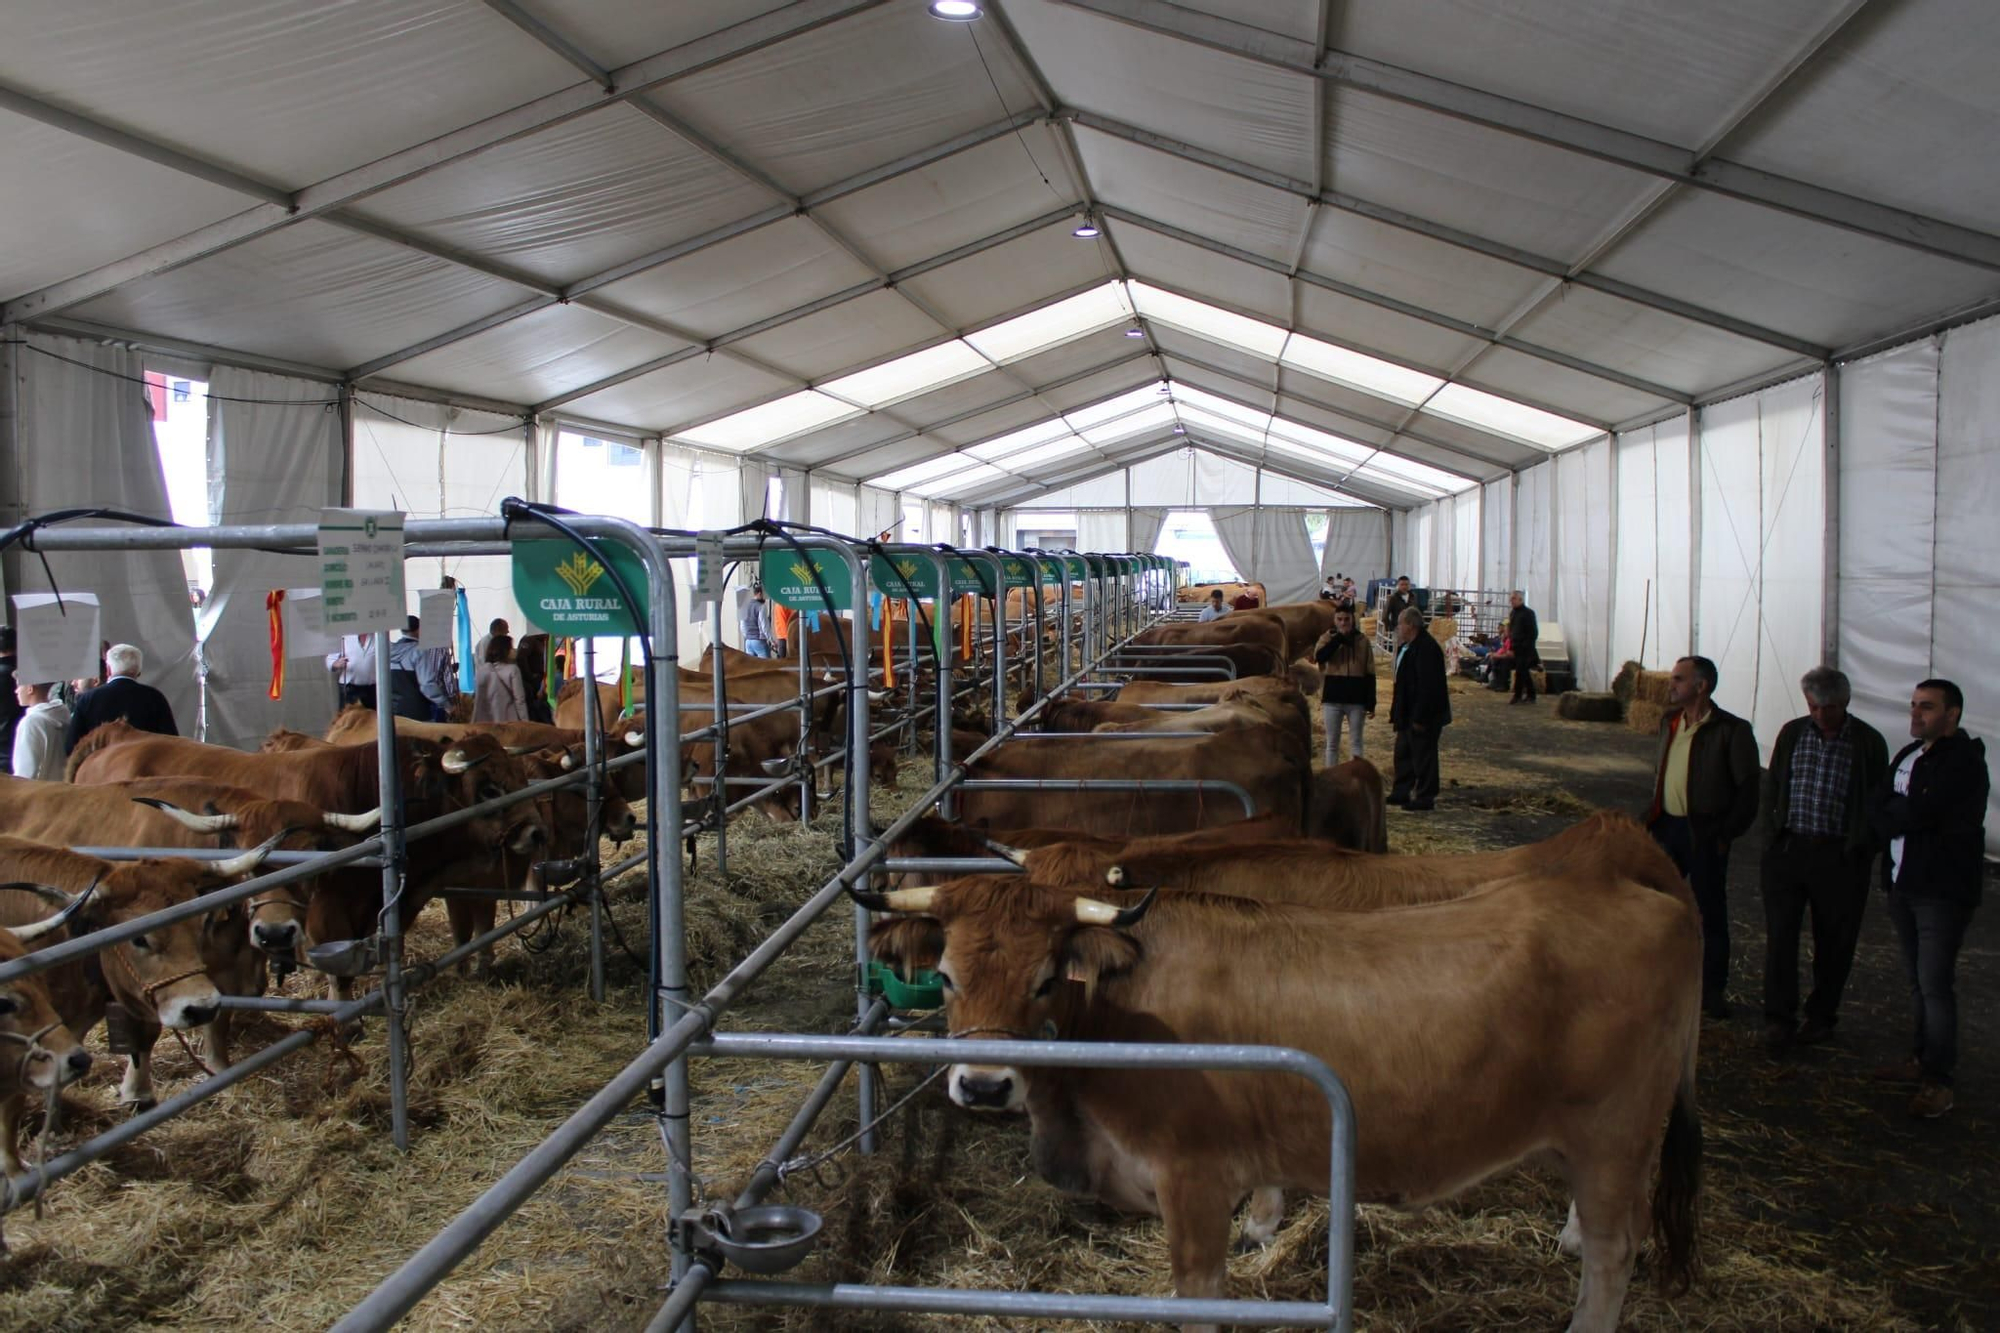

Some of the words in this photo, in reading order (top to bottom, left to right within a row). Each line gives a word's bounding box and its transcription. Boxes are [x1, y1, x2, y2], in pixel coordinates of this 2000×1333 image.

[780, 587, 801, 595] CAJA
[540, 599, 571, 610] CAJA
[575, 598, 622, 610] RURAL
[553, 613, 566, 621] DE
[567, 613, 609, 621] ASTURIAS
